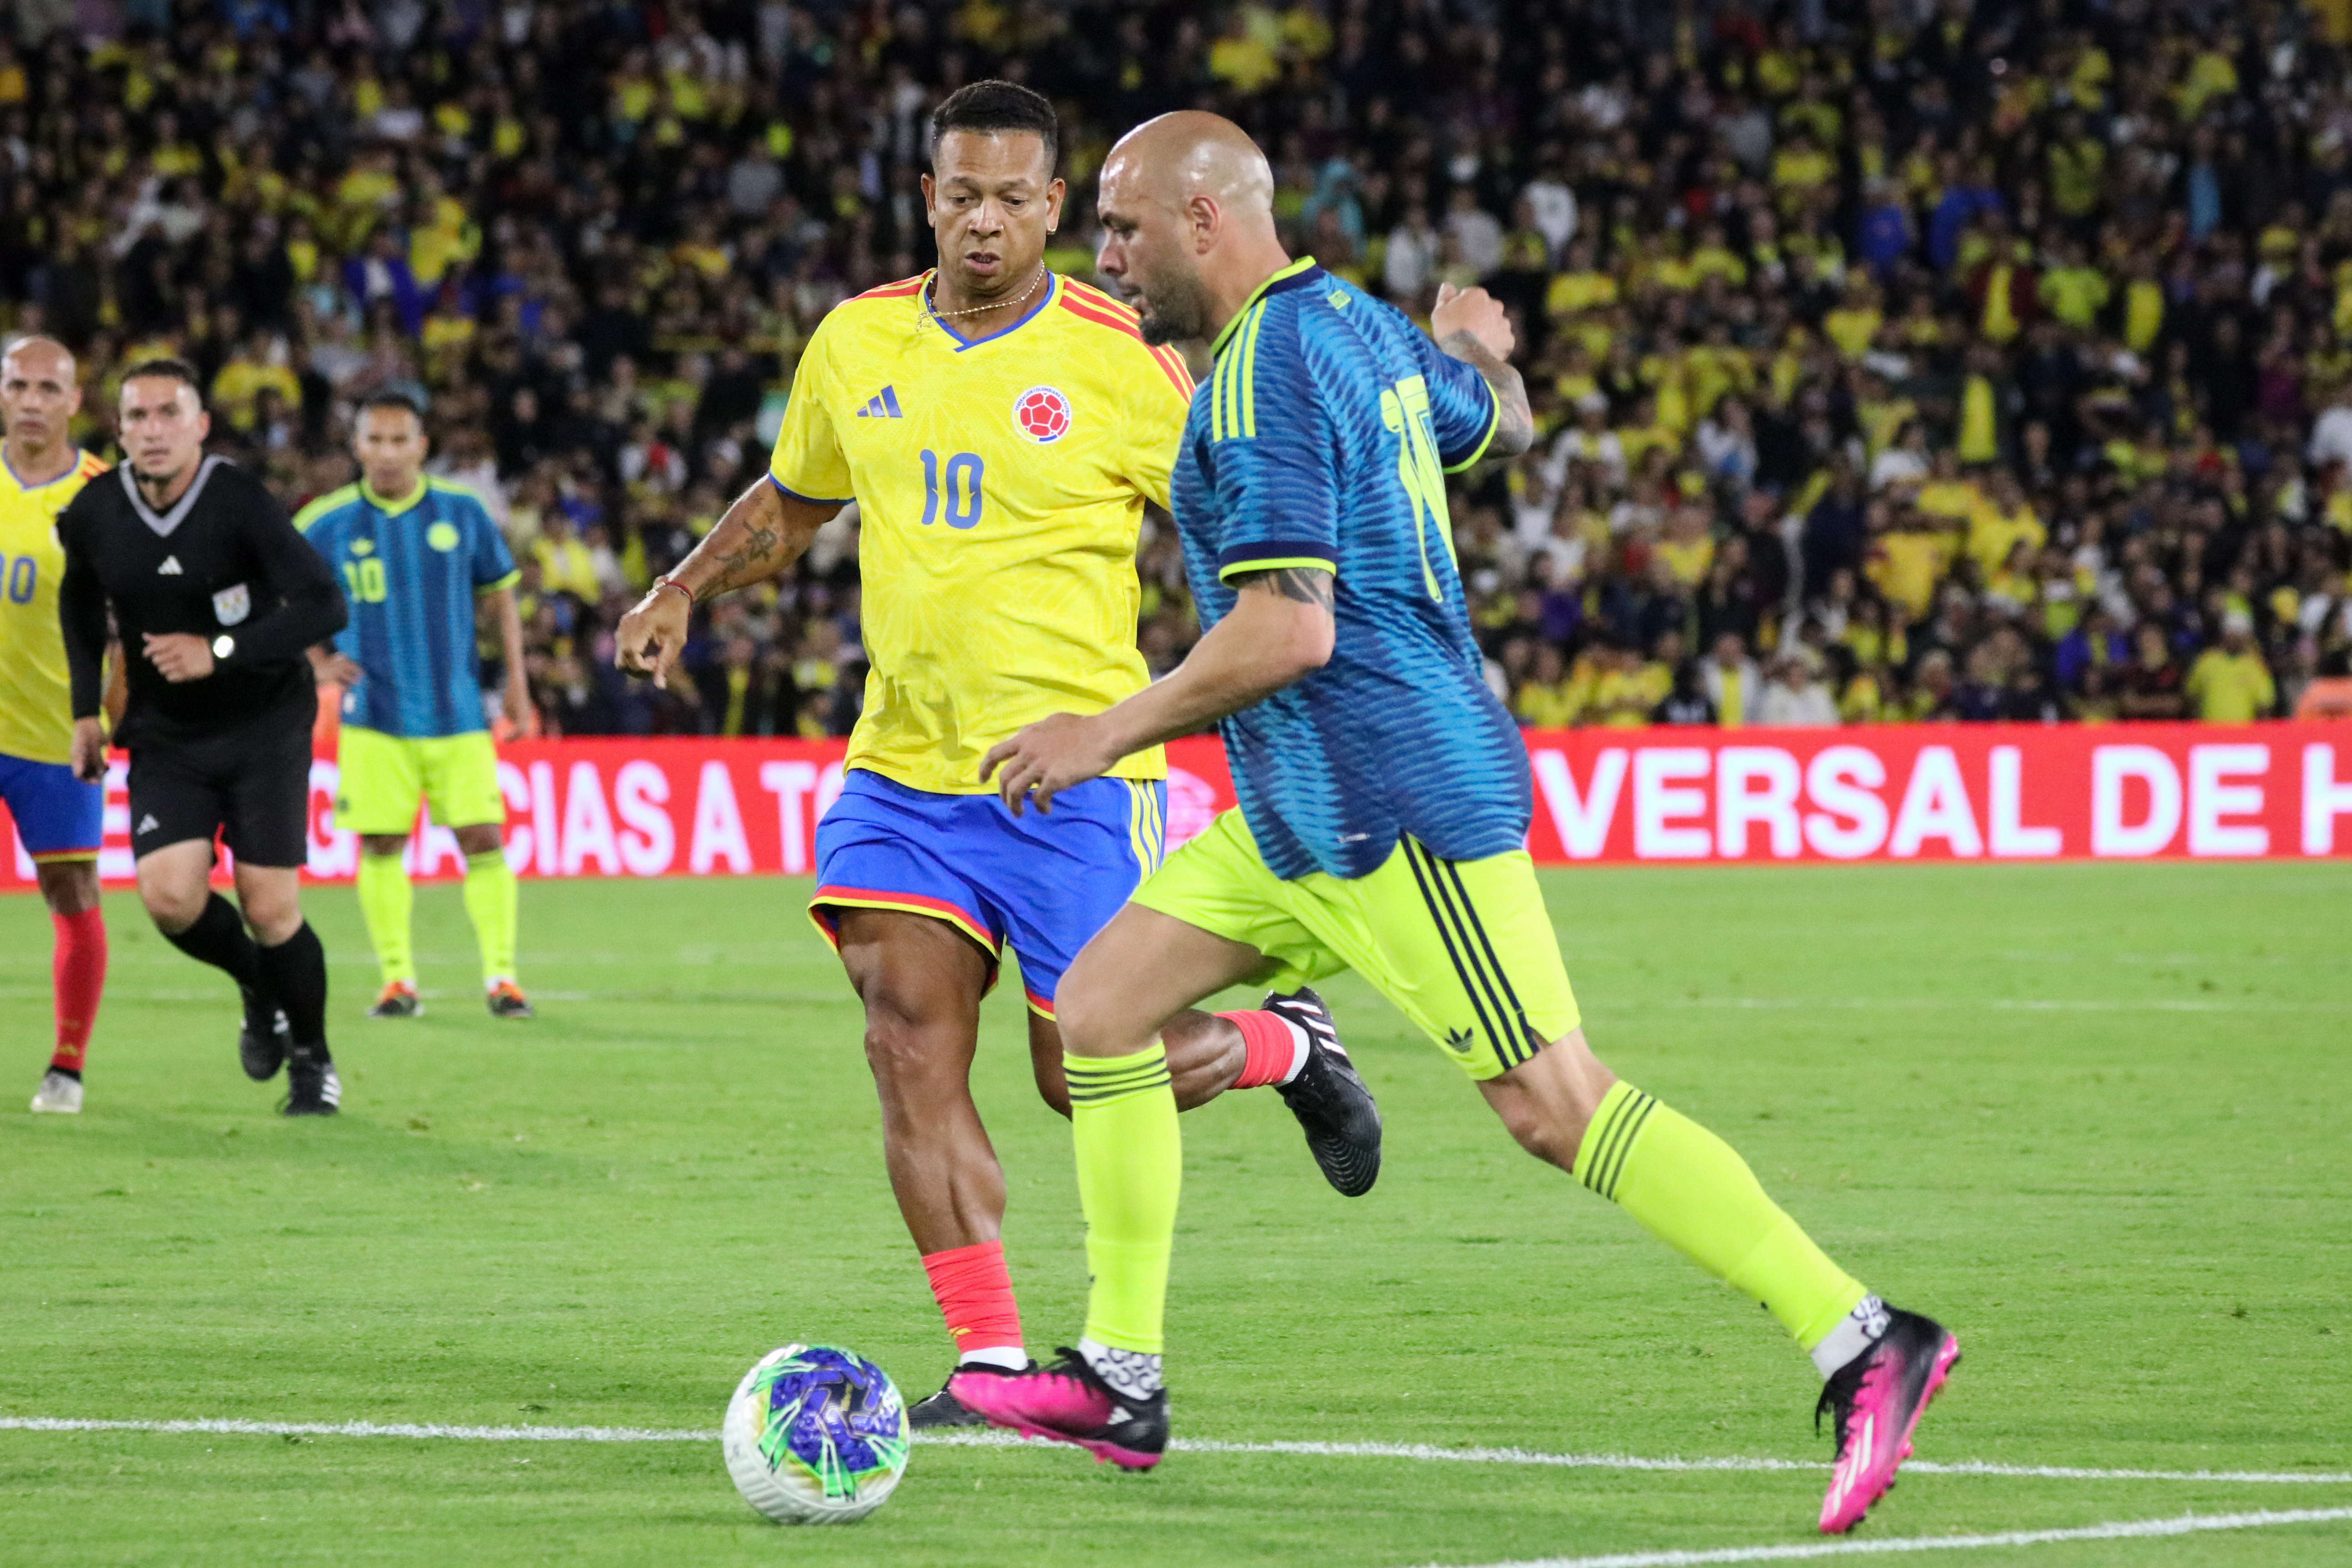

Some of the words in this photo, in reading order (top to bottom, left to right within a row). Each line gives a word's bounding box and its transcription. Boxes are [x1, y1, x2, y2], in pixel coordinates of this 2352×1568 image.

[1033, 387, 1060, 397] COLOMBIANA
[920, 449, 984, 529] 10
[343, 557, 387, 604] 10
[690, 759, 752, 875] A
[2091, 742, 2271, 857] DE
